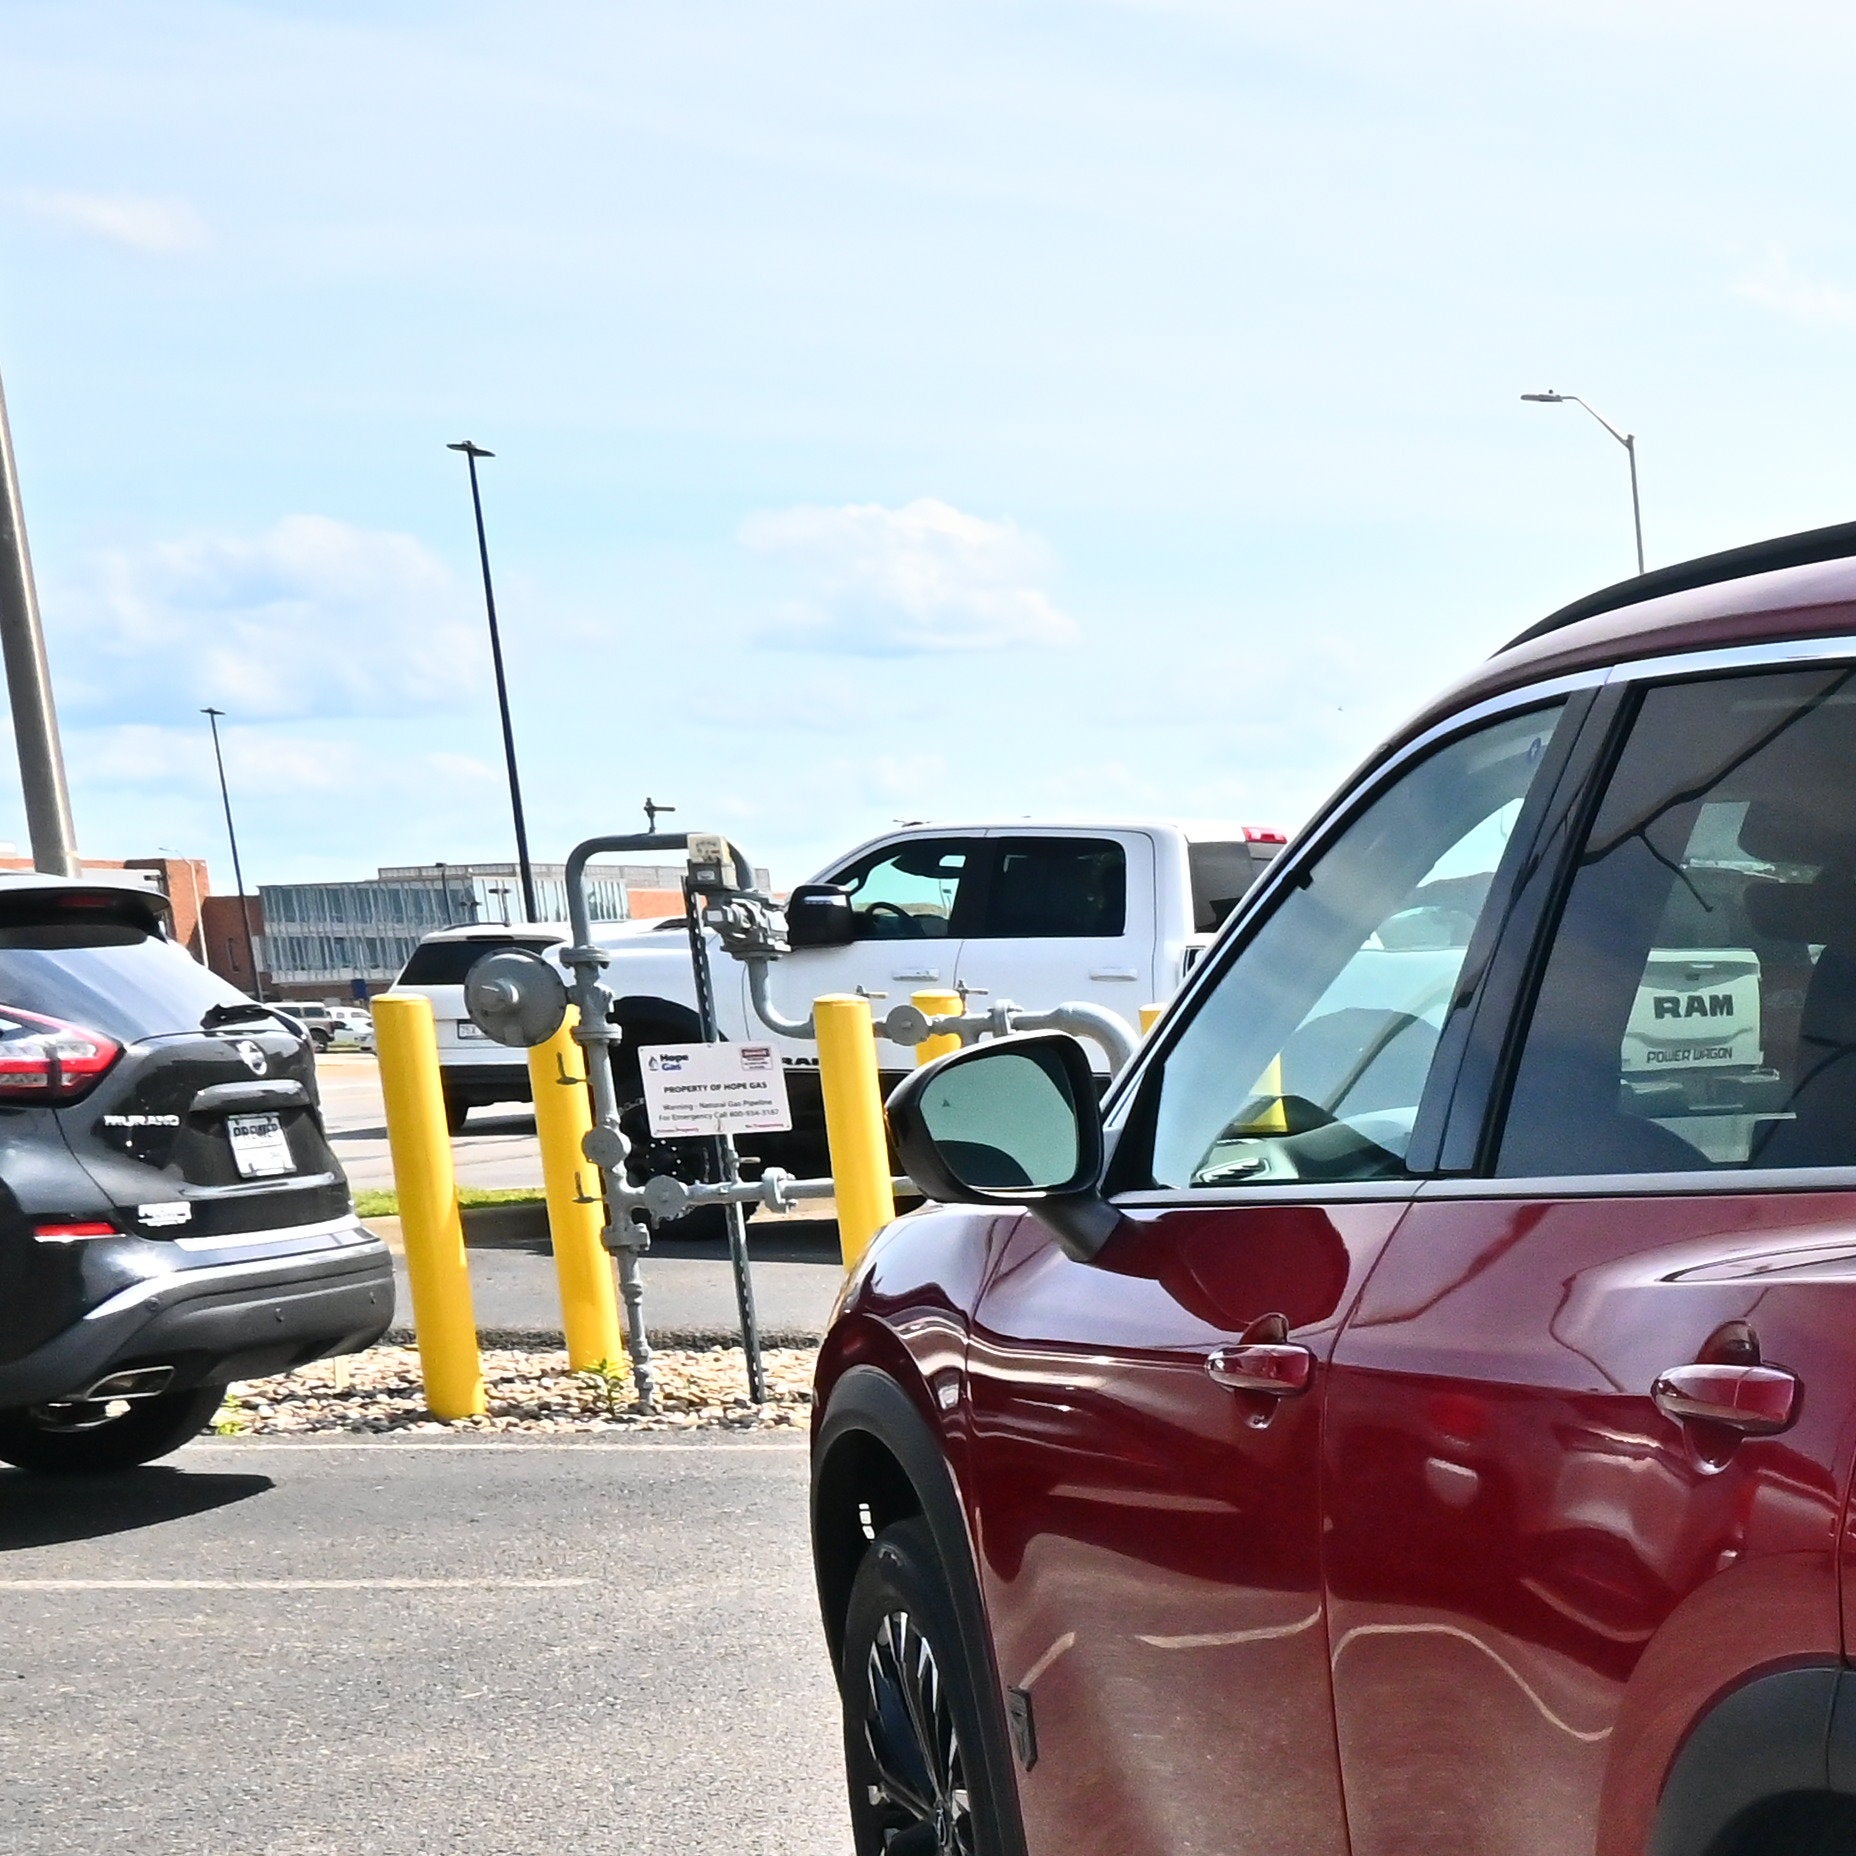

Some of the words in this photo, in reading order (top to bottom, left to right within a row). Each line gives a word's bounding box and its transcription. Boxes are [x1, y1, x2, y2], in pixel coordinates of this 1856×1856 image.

[1653, 993, 1734, 1019] RAM
[660, 1053, 689, 1063] Hope
[1646, 1050, 1691, 1064] POWER
[1692, 1047, 1733, 1061] WAGON
[661, 1062, 682, 1071] Gas
[664, 1084, 708, 1094] PROPERTY
[710, 1083, 722, 1092] OF
[724, 1081, 748, 1090] HOPE
[749, 1081, 768, 1089] GAS
[699, 1101, 726, 1109] Natural
[743, 1099, 773, 1107] Pipeline
[671, 1112, 713, 1121] Emergency
[714, 1110, 728, 1119] Call
